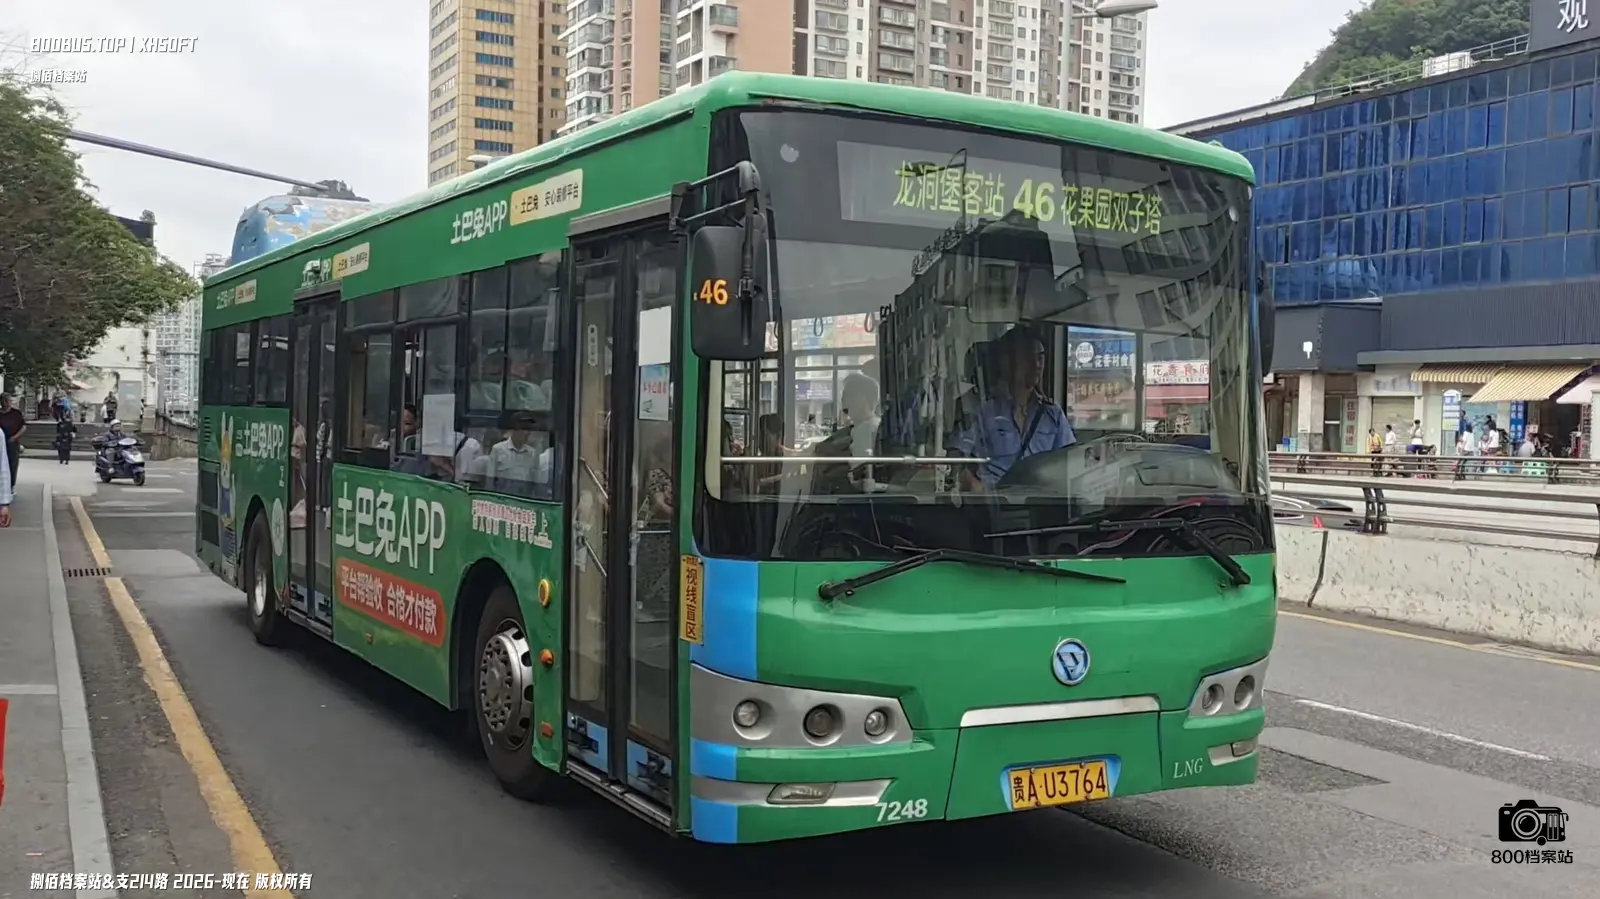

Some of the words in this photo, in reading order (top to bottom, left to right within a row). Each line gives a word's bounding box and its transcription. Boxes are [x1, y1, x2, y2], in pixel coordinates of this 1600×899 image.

[893, 160, 1005, 217] 龙洞堡客站
[1013, 178, 1055, 222] 46
[1061, 183, 1163, 235] 花果园双子塔
[450, 200, 508, 244] 土巴兔APP
[700, 279, 728, 305] 46
[243, 421, 284, 460] 土巴兔APP
[335, 481, 446, 575] 土巴兔APP
[340, 565, 384, 613] 平台帮验收
[386, 583, 437, 636] 合格才付款
[686, 566, 698, 640] 视线盲区
[1173, 758, 1204, 779] LNG
[875, 798, 929, 822] 7248
